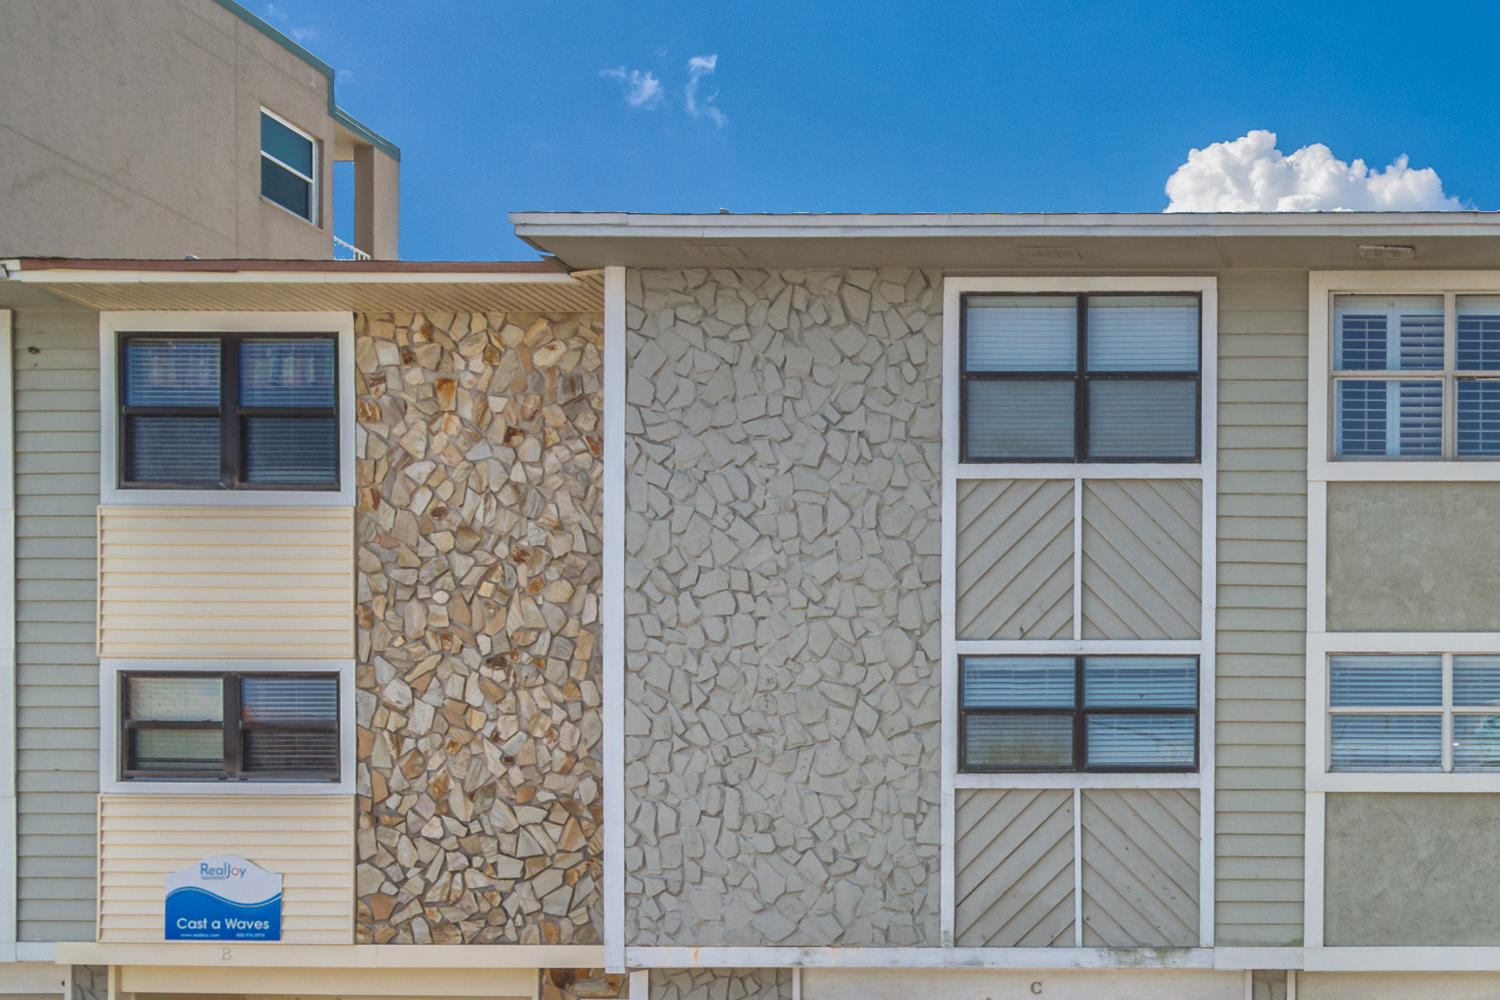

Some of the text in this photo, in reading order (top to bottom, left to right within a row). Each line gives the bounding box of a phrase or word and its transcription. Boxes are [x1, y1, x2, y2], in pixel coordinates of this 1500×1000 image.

[200, 862, 246, 879] RealJoy
[176, 918, 270, 929] Cast a Waves
[1030, 981, 1042, 995] C
